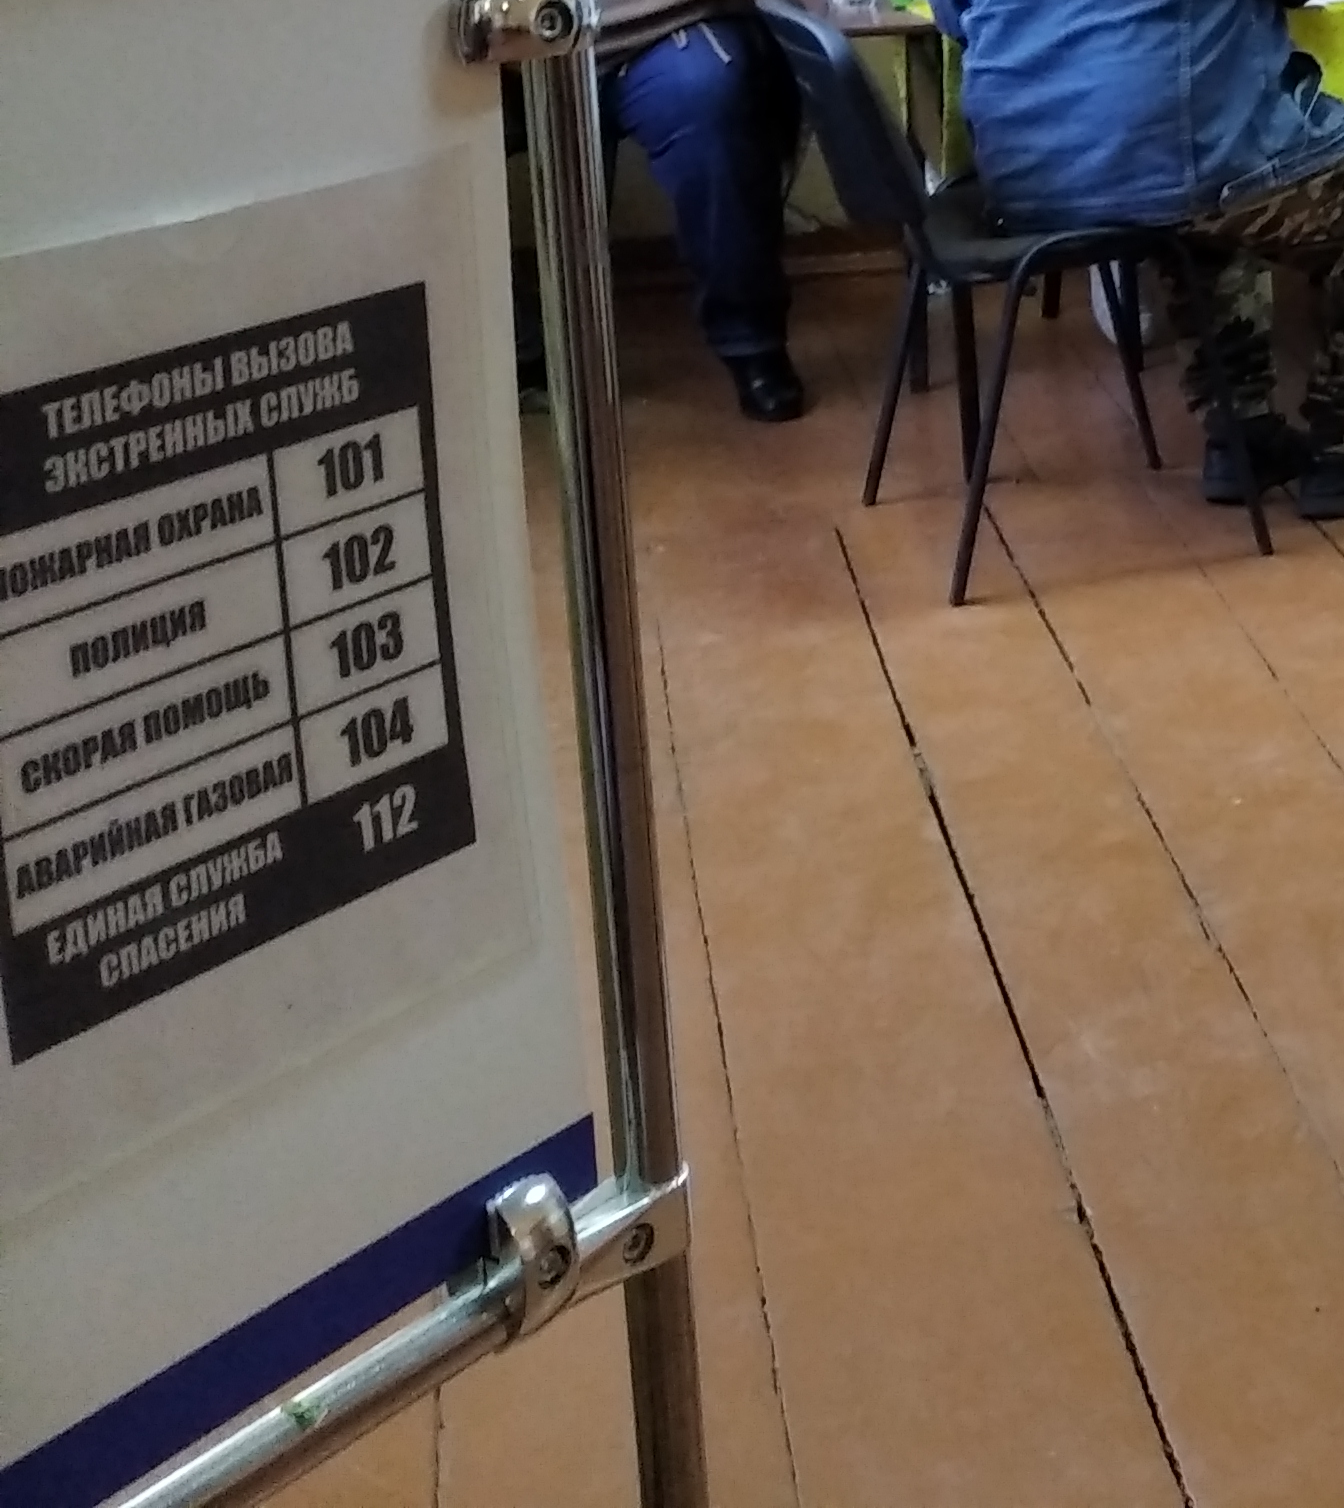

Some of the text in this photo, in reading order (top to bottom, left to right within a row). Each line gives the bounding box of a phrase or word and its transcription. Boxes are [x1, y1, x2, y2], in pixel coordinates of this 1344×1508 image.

[41, 320, 355, 440] ТЕЛЕФОНЫ ВЫЗОВА
[43, 368, 361, 493] ЭКСТРЕННЫХ СЛУЖБ
[156, 486, 265, 548] ОХРАНА
[316, 432, 385, 498] 101
[69, 523, 397, 679] ПОЛИЦИЯ 102
[20, 609, 404, 794] СКОРАЯ ПОМОЩЬ 103
[15, 695, 415, 900] АВАРИЙНАЯ ГАЗОВАЯ 104
[45, 783, 420, 966] ЕДИНАЯ СЛУЖБА 112
[99, 891, 248, 988] СПАСЕНИЯ
